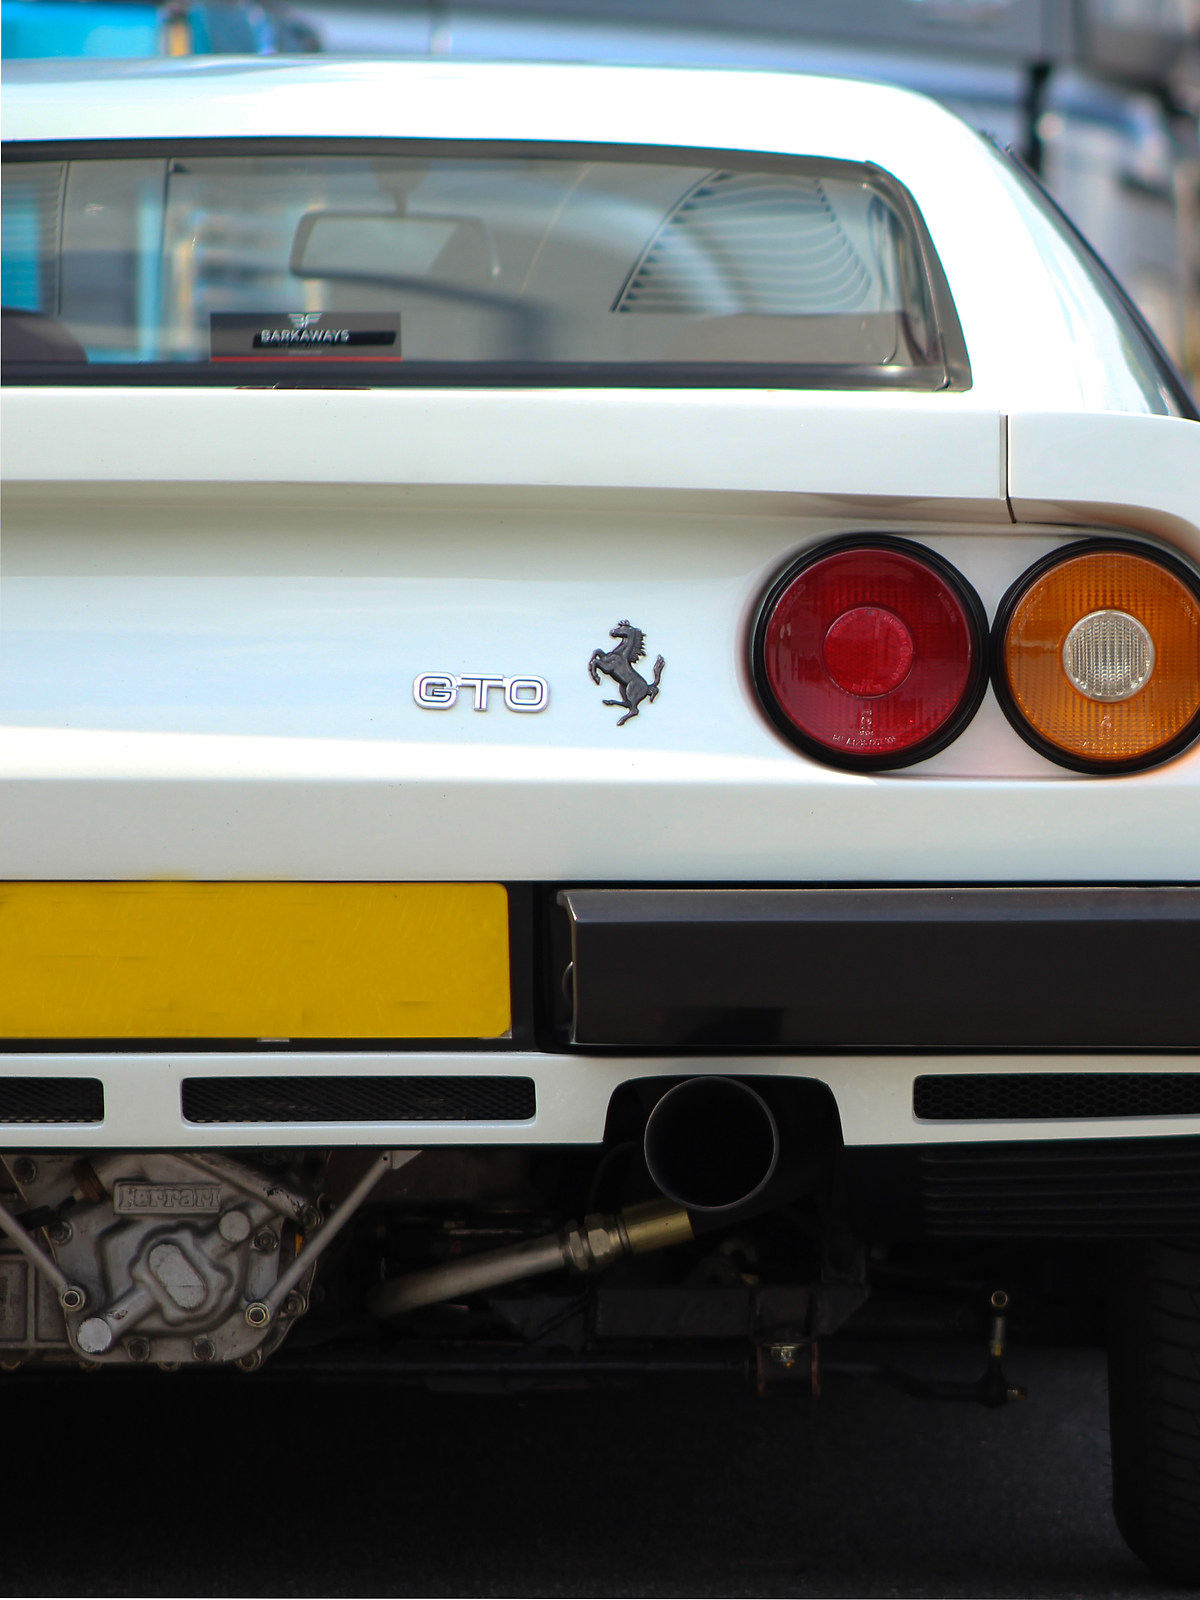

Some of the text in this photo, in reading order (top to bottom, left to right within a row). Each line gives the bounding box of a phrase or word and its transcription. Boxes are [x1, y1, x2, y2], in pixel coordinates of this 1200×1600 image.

[260, 328, 350, 343] BARKAWAYS
[412, 671, 550, 713] GTO
[118, 1187, 221, 1208] Ferrari
